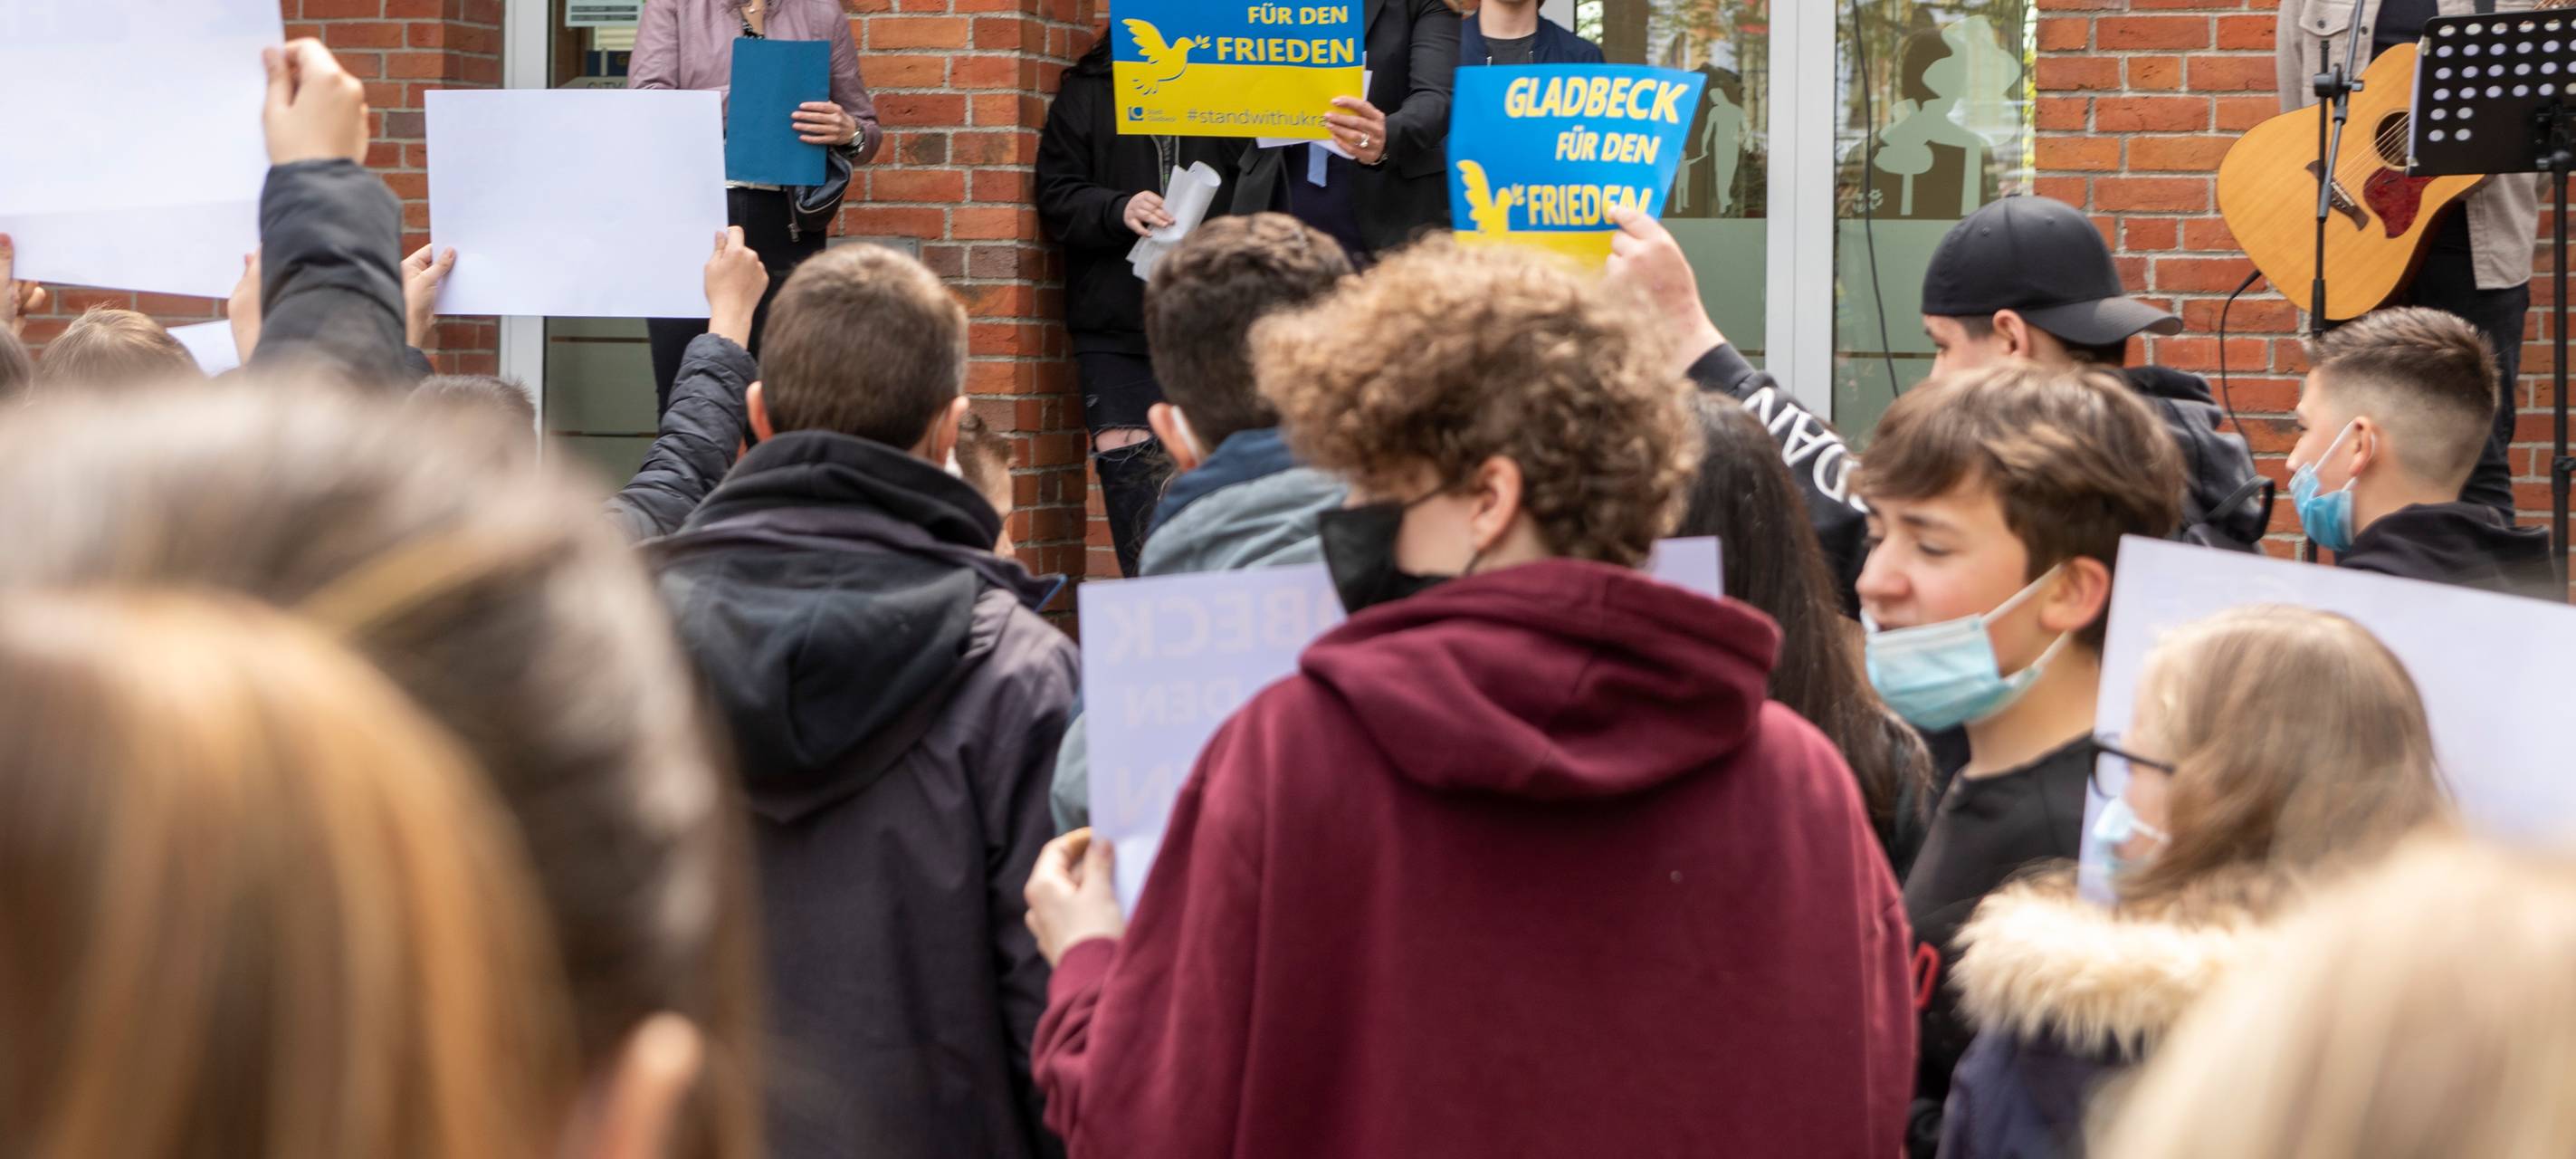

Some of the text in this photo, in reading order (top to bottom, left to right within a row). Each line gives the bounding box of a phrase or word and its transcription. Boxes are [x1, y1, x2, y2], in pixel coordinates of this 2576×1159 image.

[1247, 3, 1348, 24] FÜR DEN
[1216, 36, 1354, 63] FRIEDEN
[1505, 77, 1688, 123] GLADBECK
[1187, 108, 1327, 128] #standwithukra
[1555, 125, 1661, 165] FÜR DEN
[1741, 387, 1869, 512] DAN
